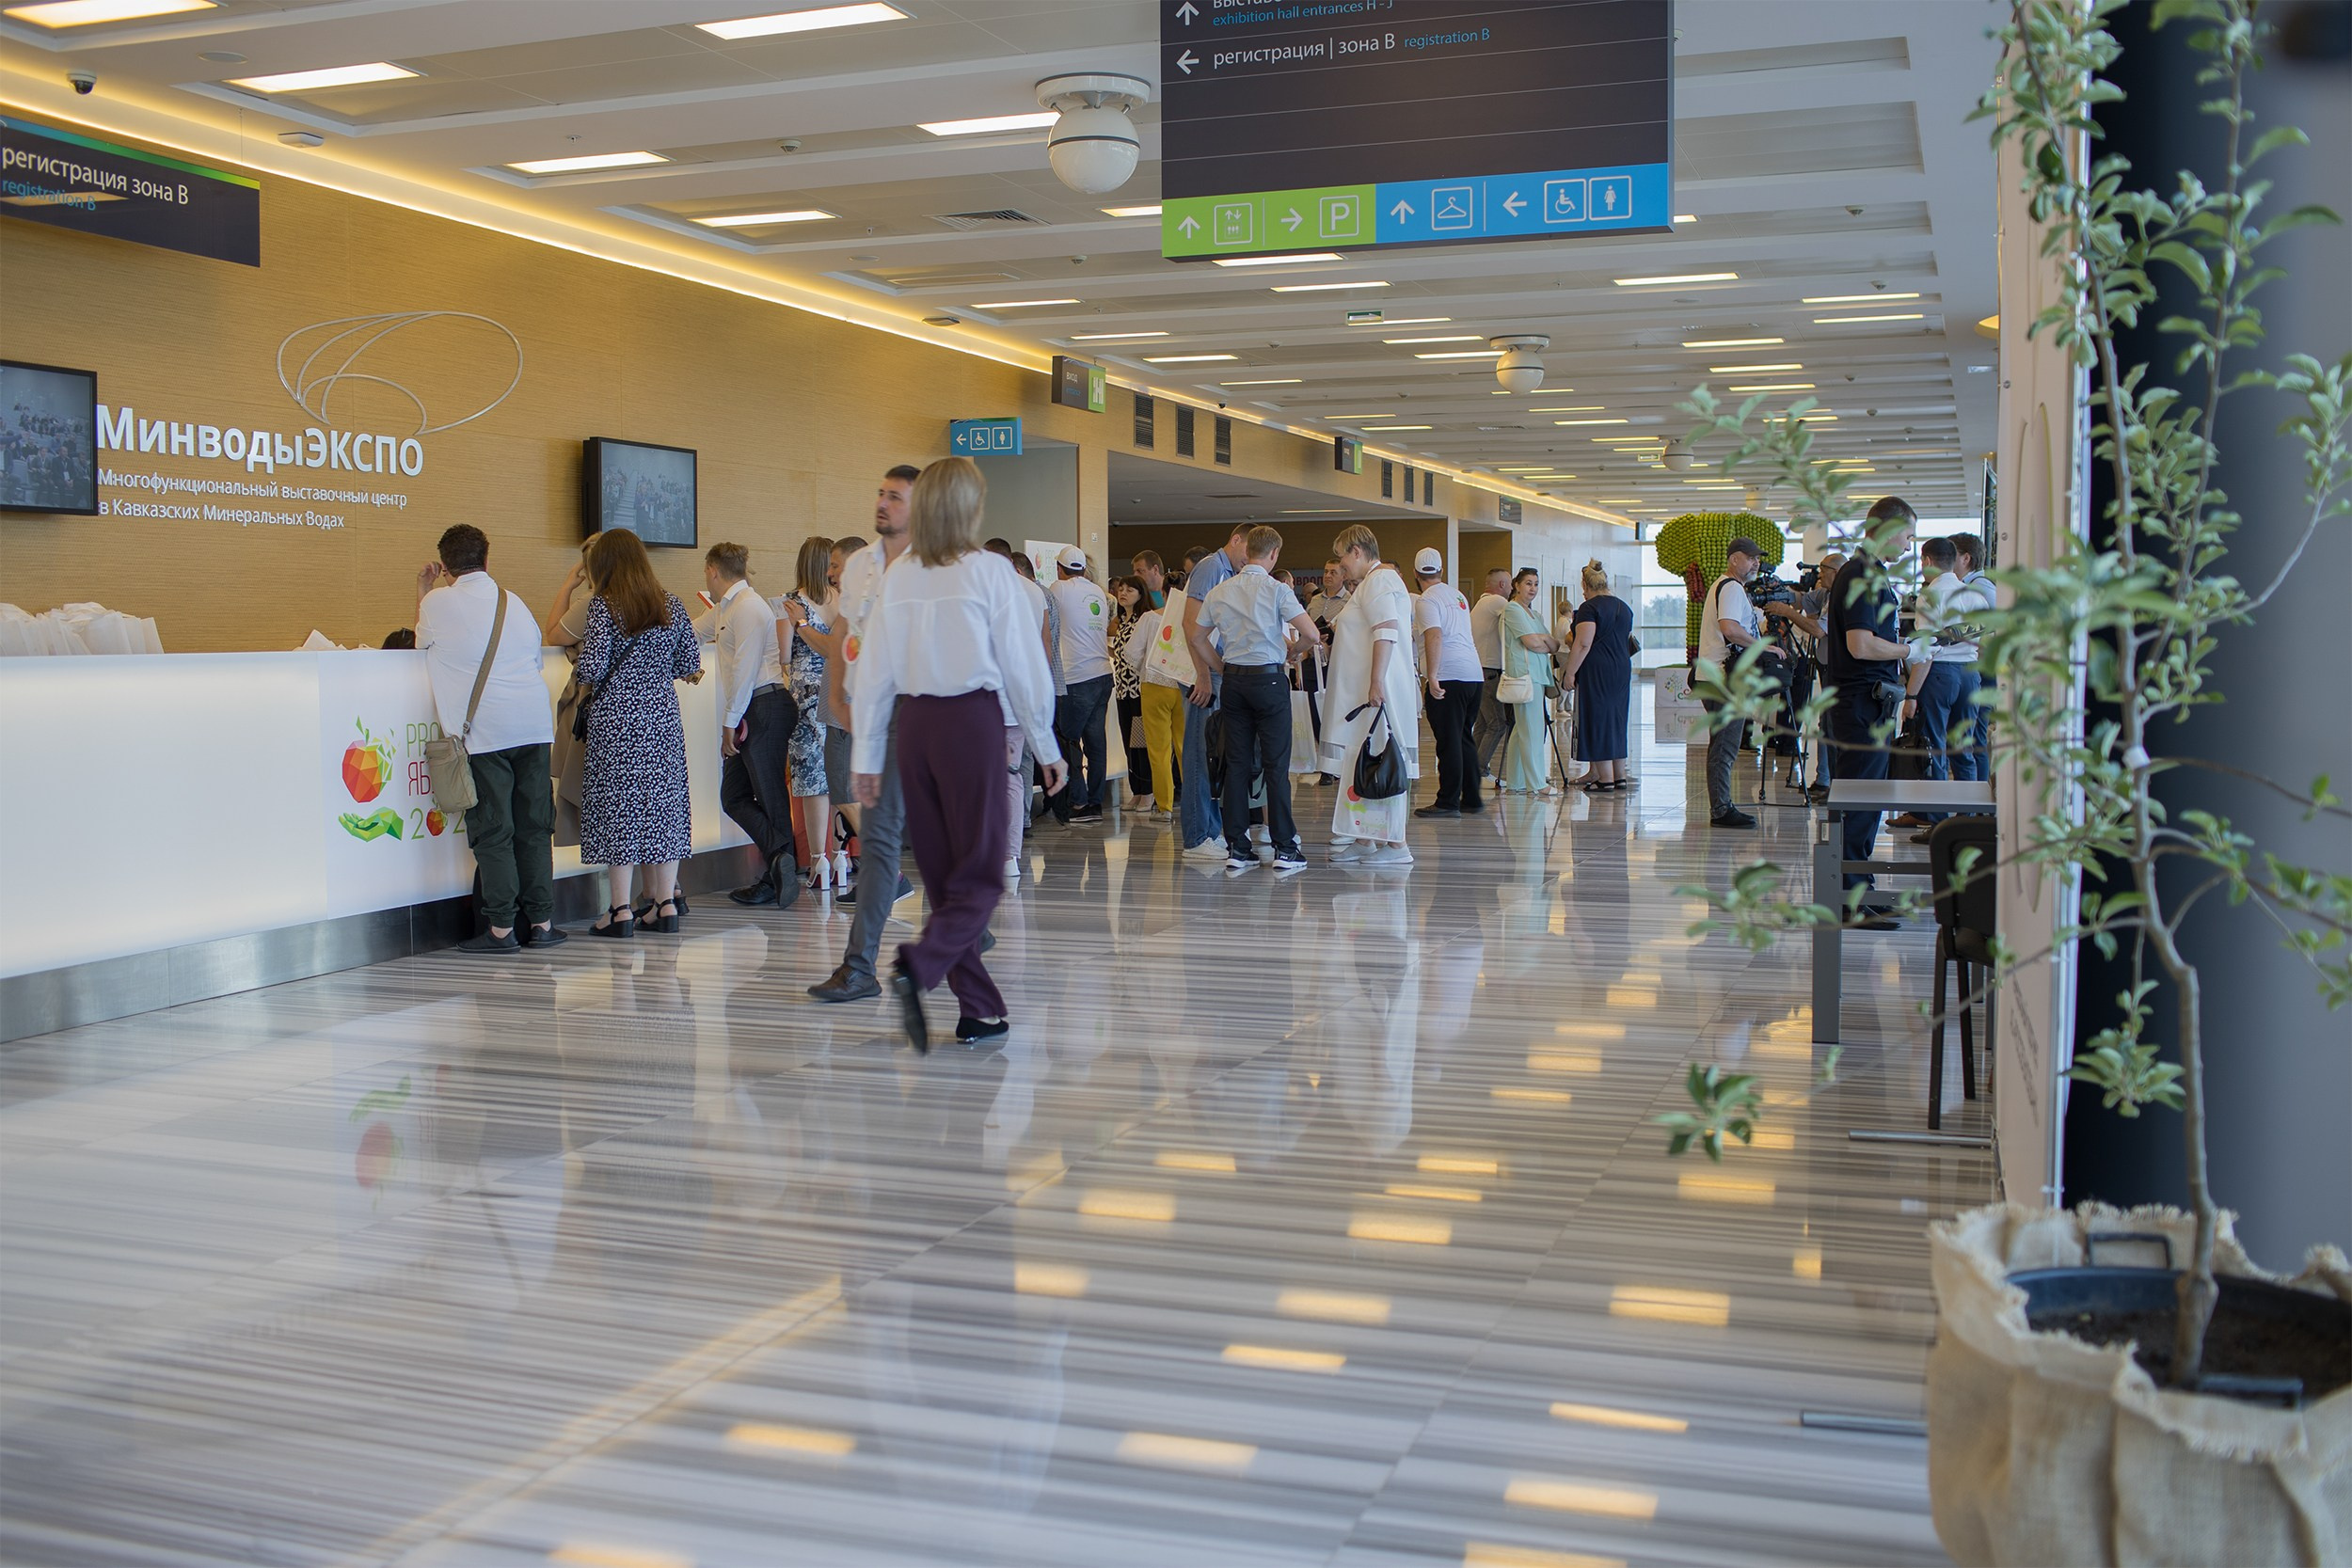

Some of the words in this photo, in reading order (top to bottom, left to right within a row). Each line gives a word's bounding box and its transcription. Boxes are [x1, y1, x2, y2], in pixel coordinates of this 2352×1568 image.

[1213, 10, 1275, 26] exhibition
[1278, 6, 1299, 20] hall
[1302, 2, 1363, 17] entrances
[1366, 0, 1376, 10] H
[1214, 43, 1325, 69] регистрация
[1338, 39, 1379, 54] зона
[1404, 31, 1478, 50] registration
[1481, 28, 1490, 40] B
[2, 147, 127, 191] регистрация
[132, 179, 173, 202] зона
[1, 179, 84, 209] registration
[87, 196, 97, 212] B
[96, 404, 423, 477] МинводыЭКСПО
[98, 468, 278, 498] Многофункциональный
[281, 485, 369, 504] выставочный
[372, 492, 407, 510] центр
[99, 502, 109, 515] в
[112, 499, 199, 520] Кавказских
[203, 504, 303, 527] Минеральных
[306, 511, 344, 530] Водах
[407, 761, 435, 797] ЯБ
